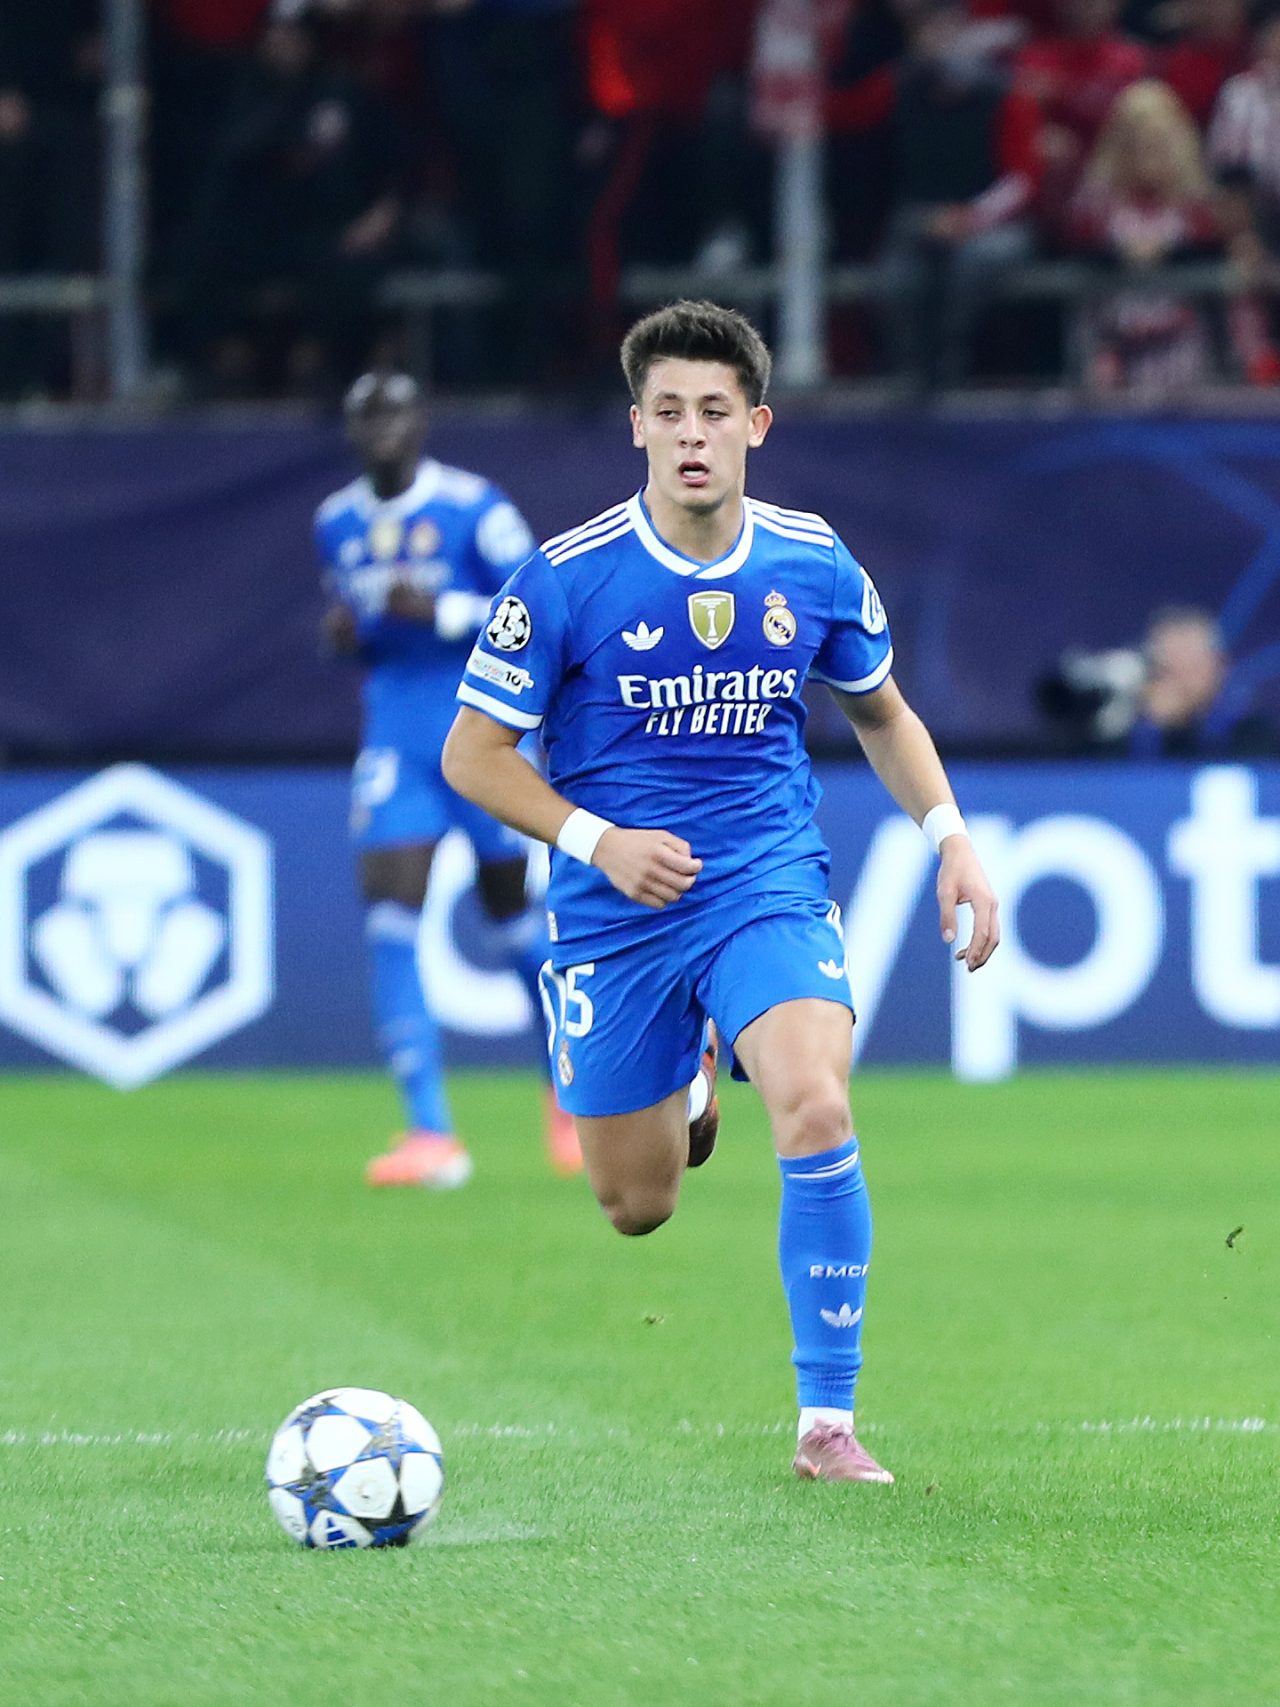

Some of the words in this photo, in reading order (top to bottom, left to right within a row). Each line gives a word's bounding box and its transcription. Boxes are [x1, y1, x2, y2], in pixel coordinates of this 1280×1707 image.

[617, 664, 797, 709] Emirates
[645, 706, 686, 736] FLY
[690, 703, 773, 735] BETTER
